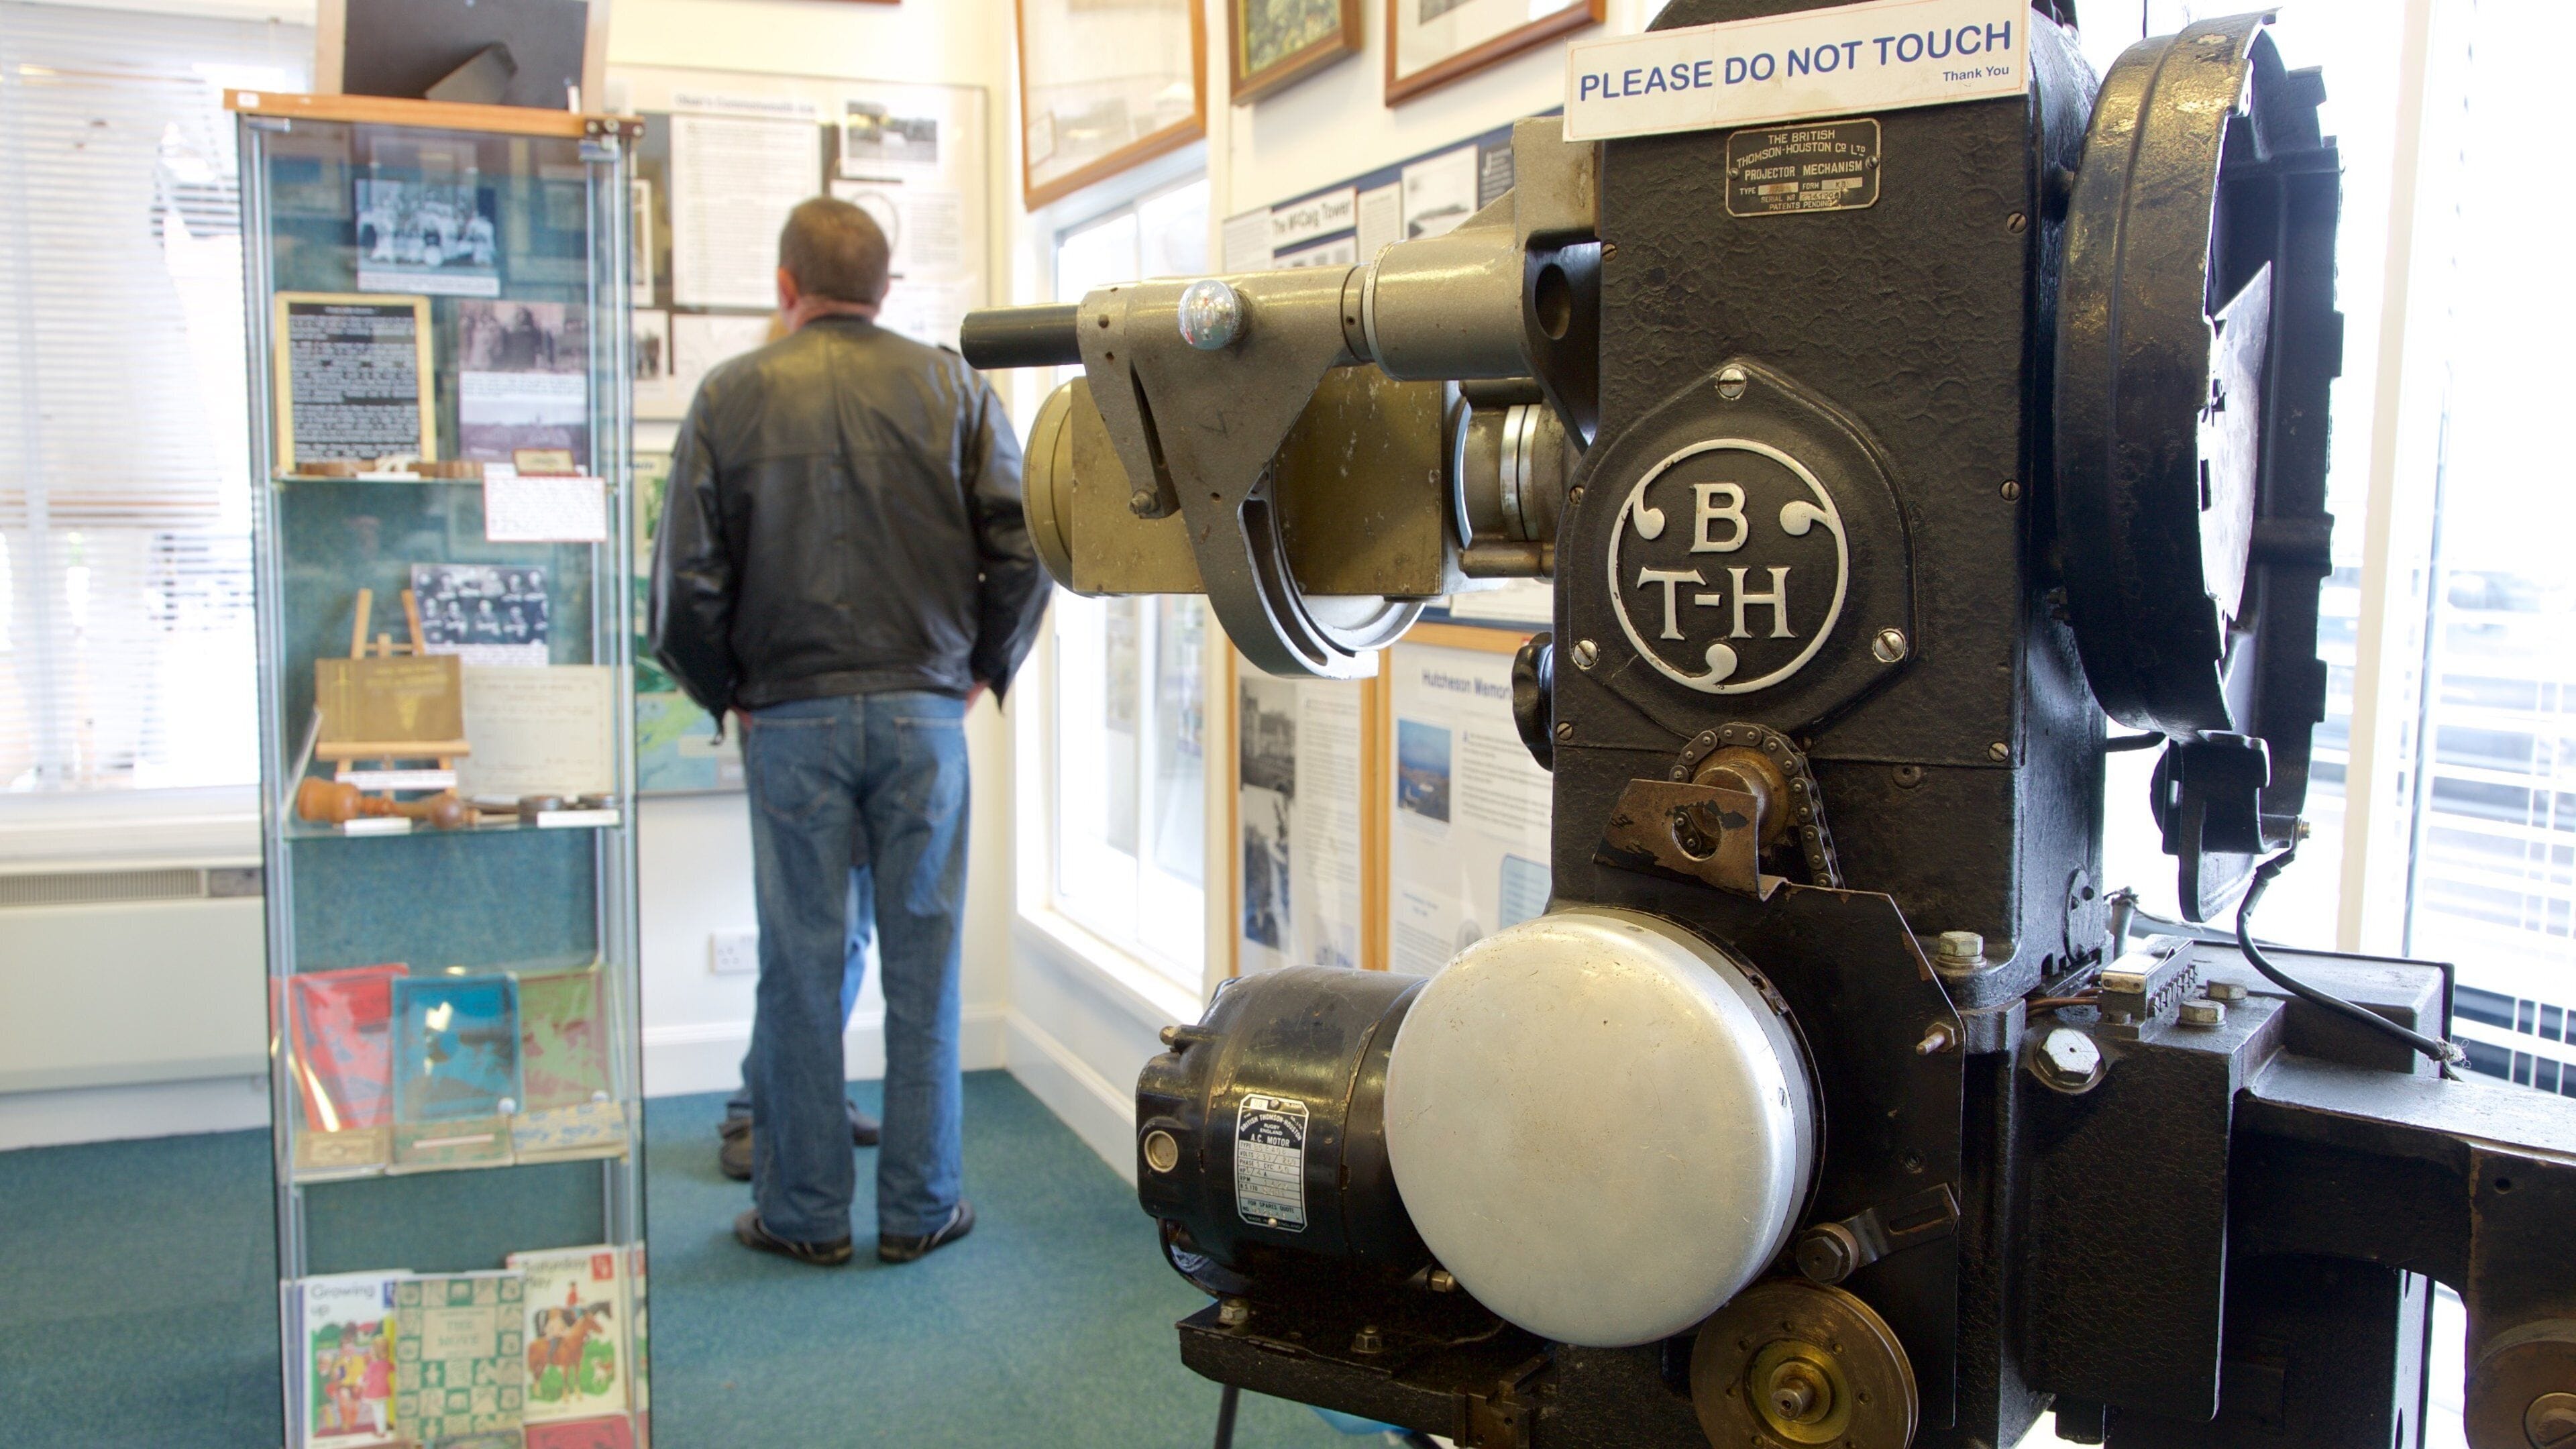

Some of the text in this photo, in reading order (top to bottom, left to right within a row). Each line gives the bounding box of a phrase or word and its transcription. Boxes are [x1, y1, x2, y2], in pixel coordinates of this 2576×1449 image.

[1580, 20, 2010, 101] PLEASE DO NOT TOUCH
[1943, 66, 2009, 82] Thank You
[1768, 129, 1835, 145] THE BRITISH
[1736, 142, 1831, 168] THOMSON-HOUSTON
[1744, 160, 1862, 180] PROJECTOR MECHANISM
[1739, 187, 1756, 195] TYPE
[1803, 182, 1819, 190] FORM
[1321, 199, 1350, 219] Tower
[1769, 200, 1832, 211] PATENTS PENDING
[1690, 483, 1748, 552] B
[1637, 567, 1798, 641] T-H
[1240, 1113, 1302, 1141] BRITISH THOMSON-HOUSTON
[1260, 1128, 1283, 1136] ENGLAND
[1250, 1133, 1290, 1147] A.C. MOTOR
[1239, 1159, 1254, 1167] PHASE
[1259, 1201, 1277, 1210] SPARES
[311, 1283, 376, 1301] Growing
